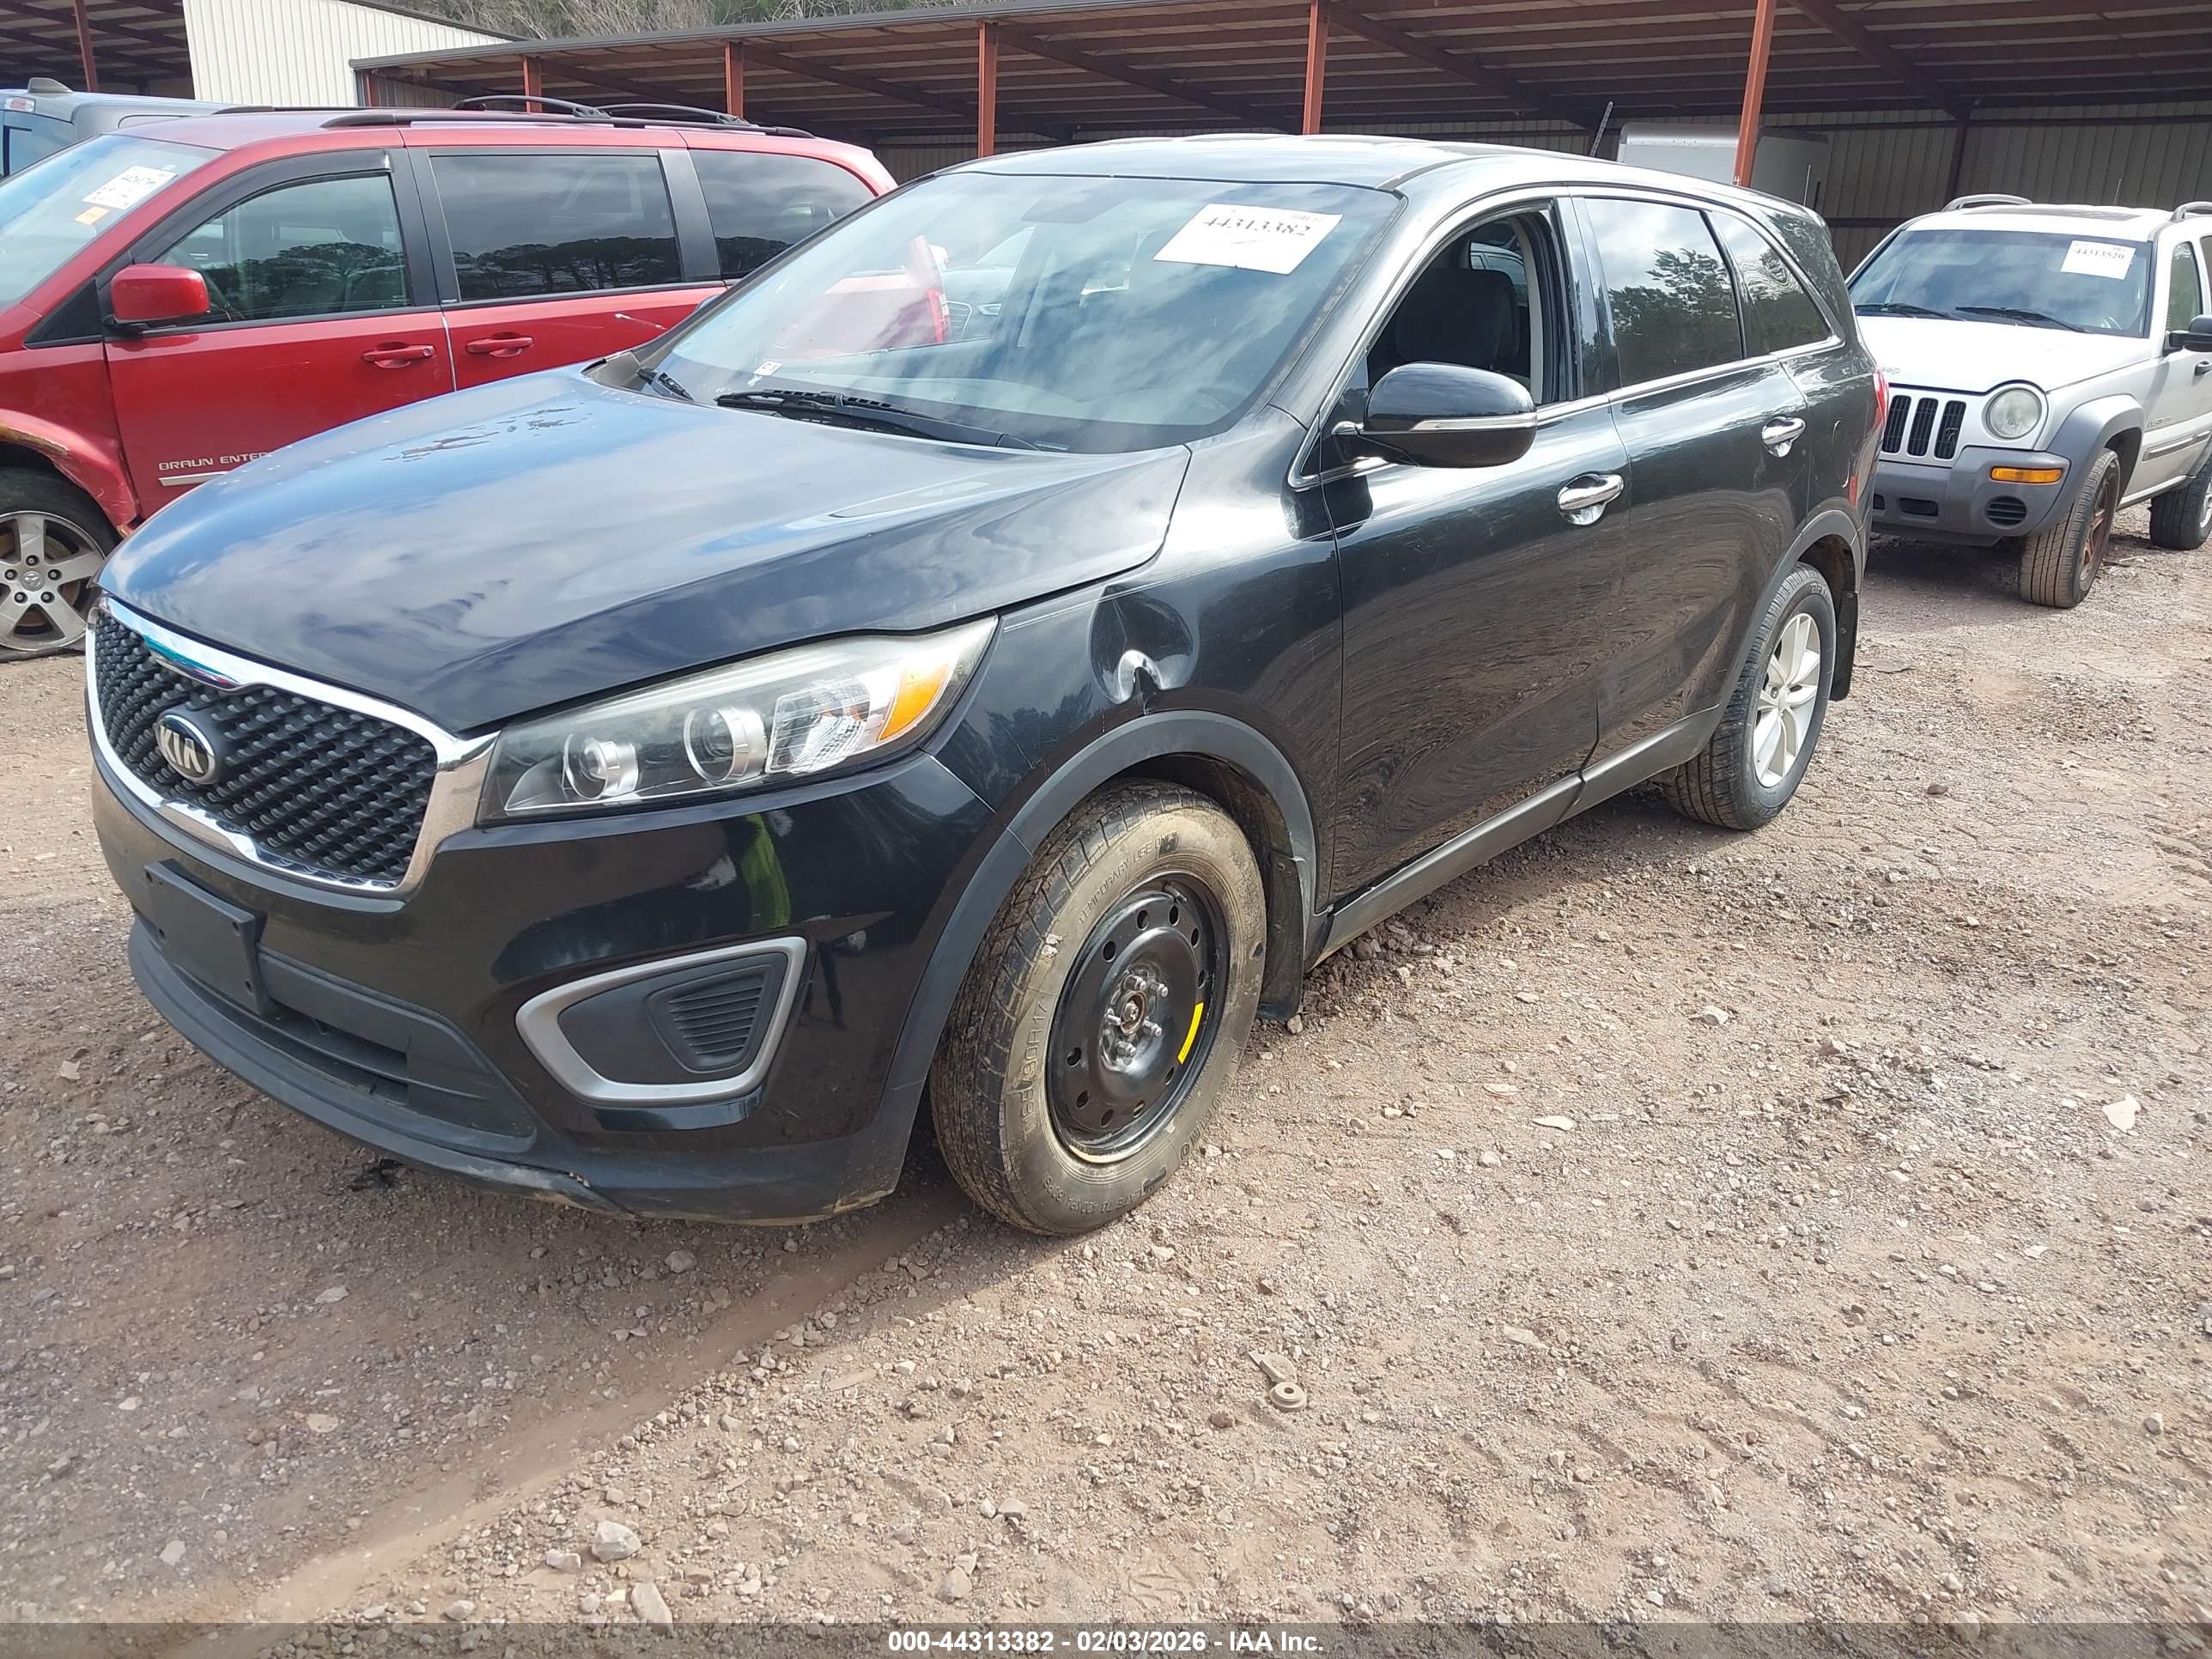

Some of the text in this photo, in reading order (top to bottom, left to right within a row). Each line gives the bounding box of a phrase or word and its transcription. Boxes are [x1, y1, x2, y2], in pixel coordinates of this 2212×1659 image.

[1204, 217, 1310, 236] 44313382
[159, 457, 214, 471] BRAUN
[160, 725, 204, 774] KIA
[1077, 858, 1129, 925] TEMPORARY
[1133, 841, 1152, 863] USE
